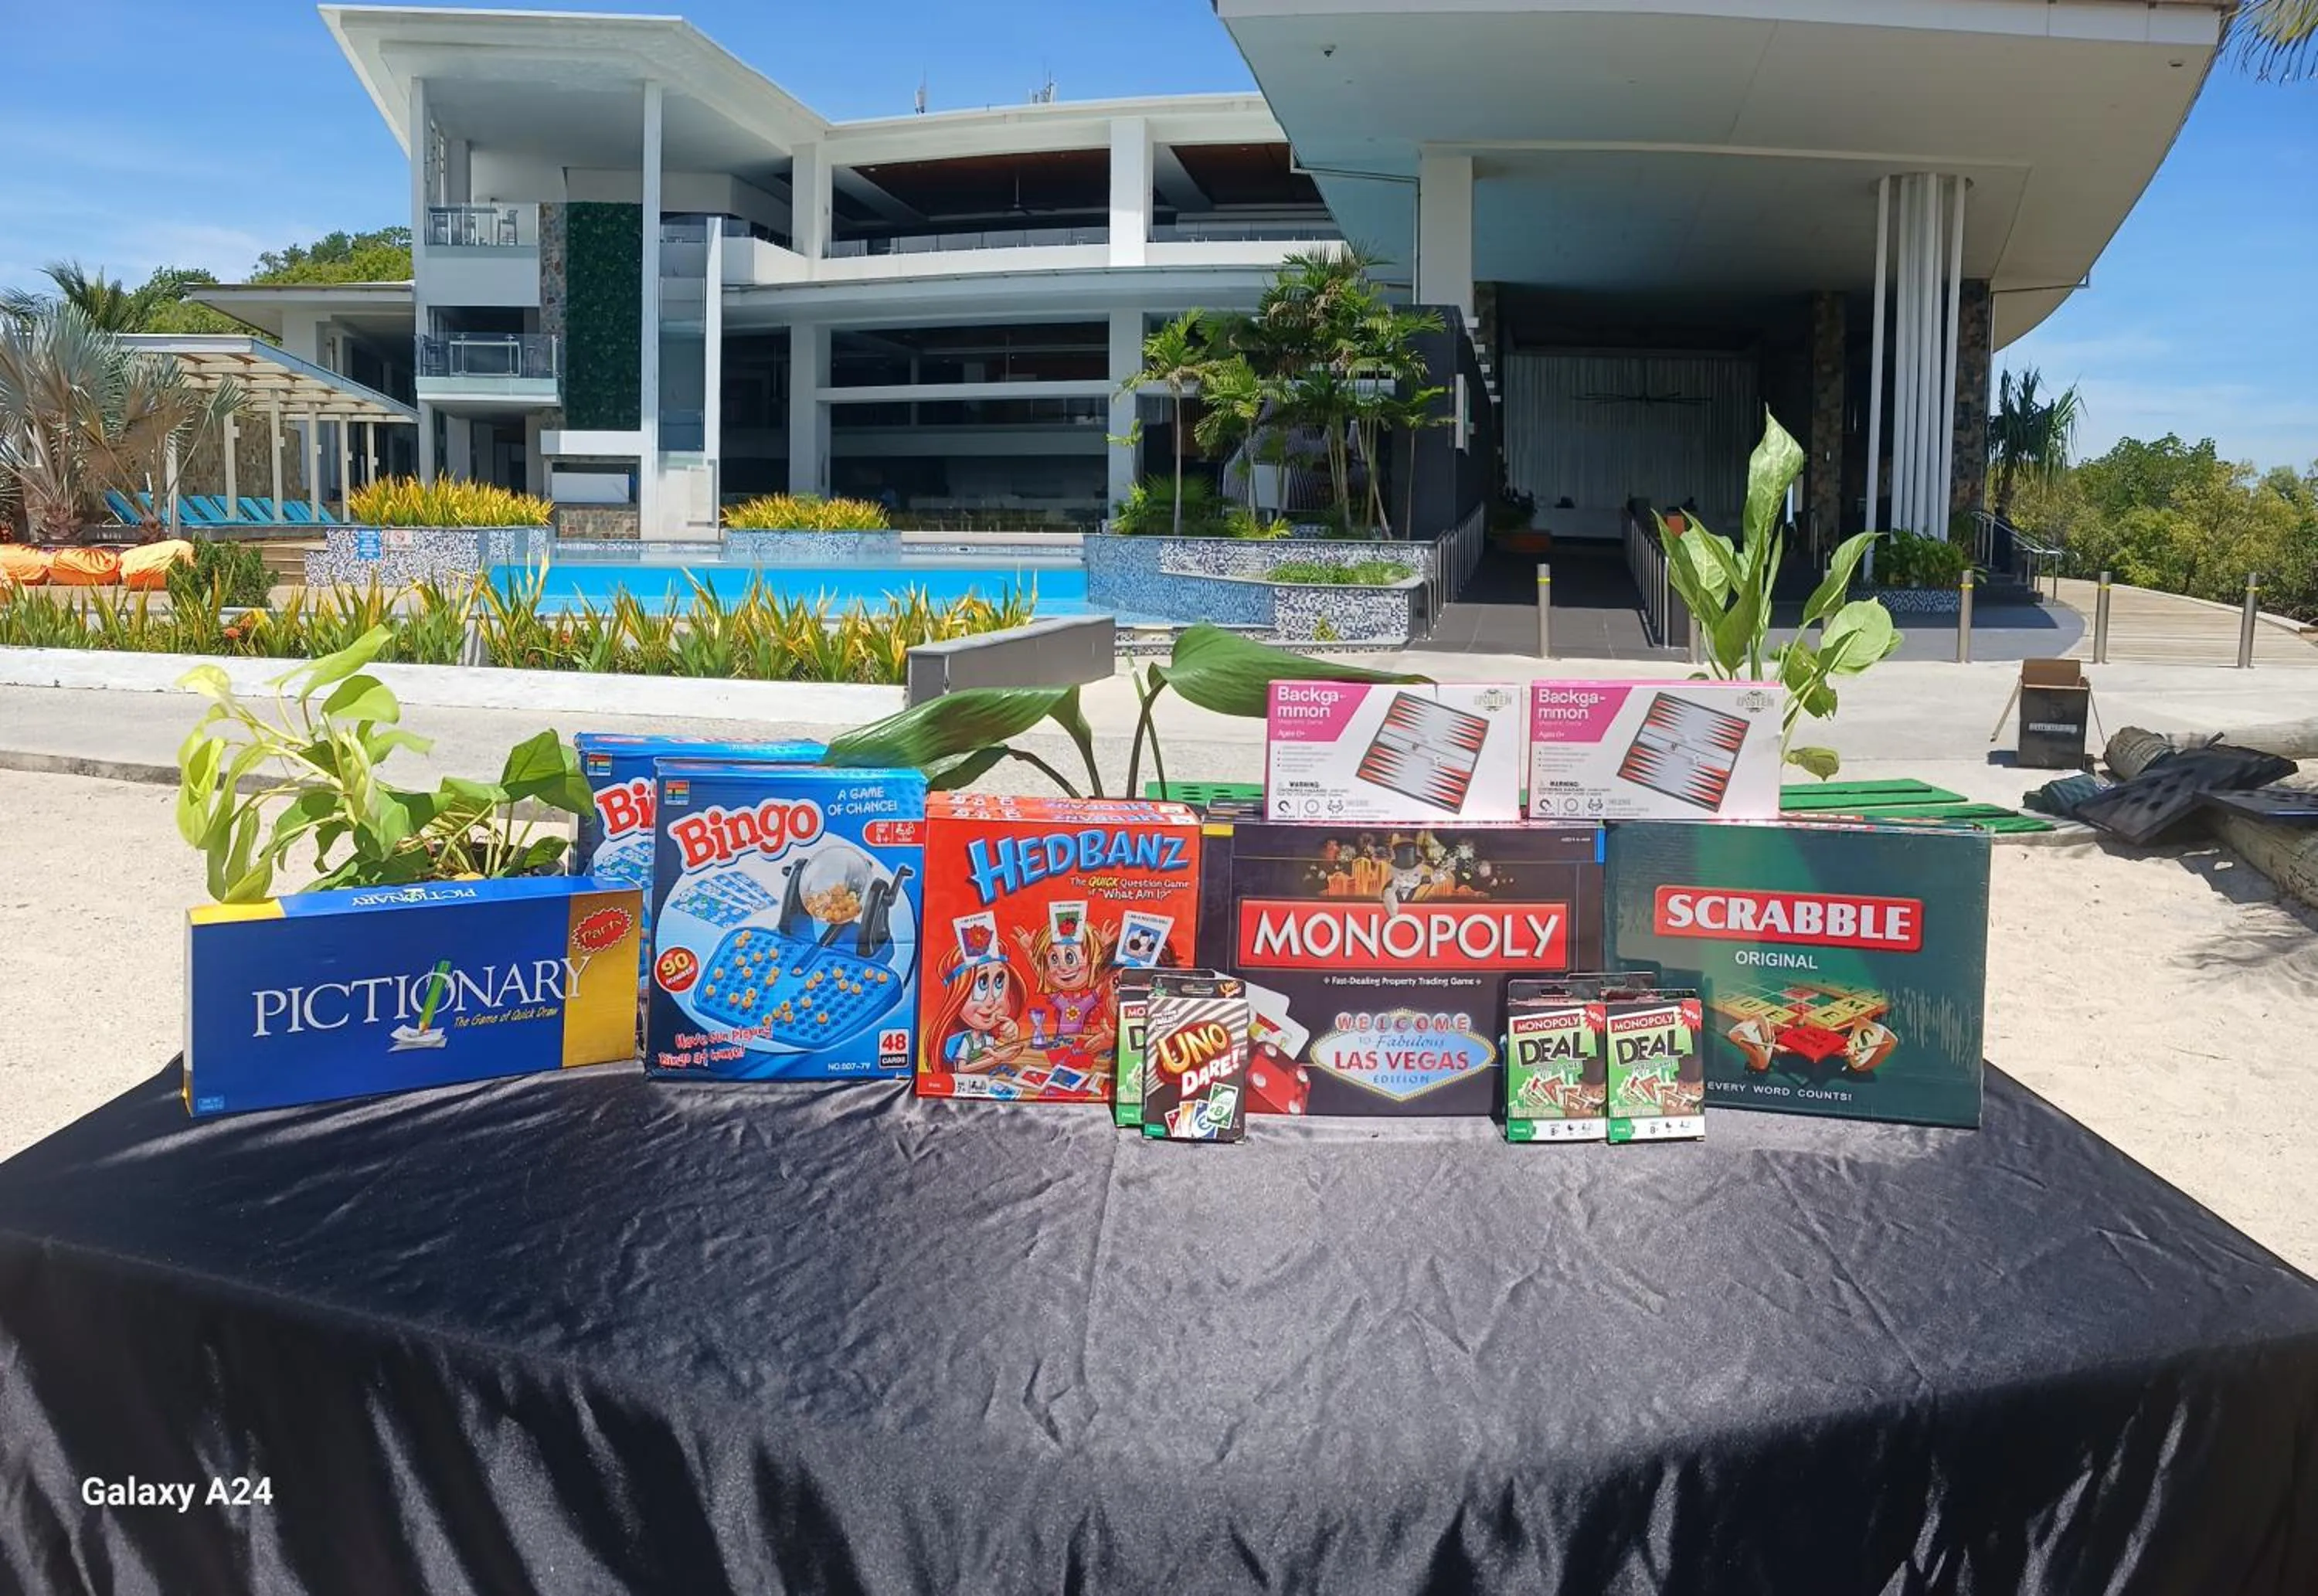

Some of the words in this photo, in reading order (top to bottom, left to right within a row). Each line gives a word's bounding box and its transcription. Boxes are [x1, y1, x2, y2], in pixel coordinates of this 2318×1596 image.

[1538, 688, 1606, 707] Backga-
[1277, 706, 1331, 718] mmon
[1538, 708, 1589, 719] mmon
[837, 789, 847, 801] A
[849, 786, 885, 800] GAME
[828, 803, 844, 817] OF
[846, 800, 898, 815] CHANCE!
[673, 800, 819, 868] Bingo
[968, 830, 1189, 904] HEDBANZ
[1069, 876, 1086, 887] The
[1088, 876, 1120, 888] QUICK
[1120, 878, 1163, 889] Question
[1164, 878, 1190, 888] Game
[1087, 888, 1096, 897] of
[1136, 889, 1154, 900] Am
[1666, 894, 1912, 941] SCRABBLE
[580, 917, 624, 943] Party
[1252, 909, 1559, 960] MONOPOLY
[661, 952, 690, 976] 90
[1735, 950, 1818, 969] ORIGINAL
[1331, 976, 1381, 987] Fast-Dealing
[1382, 976, 1417, 987] Property
[1418, 976, 1449, 988] Trading
[1450, 977, 1475, 986] Game
[252, 956, 592, 1037] PICTIONARY
[454, 1016, 470, 1029] The
[471, 1013, 498, 1026] Game
[498, 1010, 512, 1022] of
[511, 1008, 535, 1020] Quick
[536, 1006, 559, 1017] Draw
[1337, 1014, 1469, 1032] WELCOME
[1517, 1015, 1579, 1032] MONOPOLY
[1613, 1013, 1674, 1031] MONOPOLY
[882, 1033, 907, 1051] 48
[1157, 1023, 1229, 1075] UNO
[1375, 1034, 1445, 1049] Fabulous
[1518, 1031, 1589, 1066] DEAL
[1615, 1029, 1684, 1066] DEAL
[882, 1056, 906, 1065] CARDS
[1334, 1051, 1378, 1071] LAS
[1385, 1051, 1469, 1071] VEGAS
[1181, 1048, 1241, 1098] DARE!
[1372, 1074, 1430, 1084] EDITION
[1707, 1081, 1746, 1092] EVERY
[1752, 1084, 1790, 1096] WORD
[1797, 1088, 1853, 1102] COUNTS!
